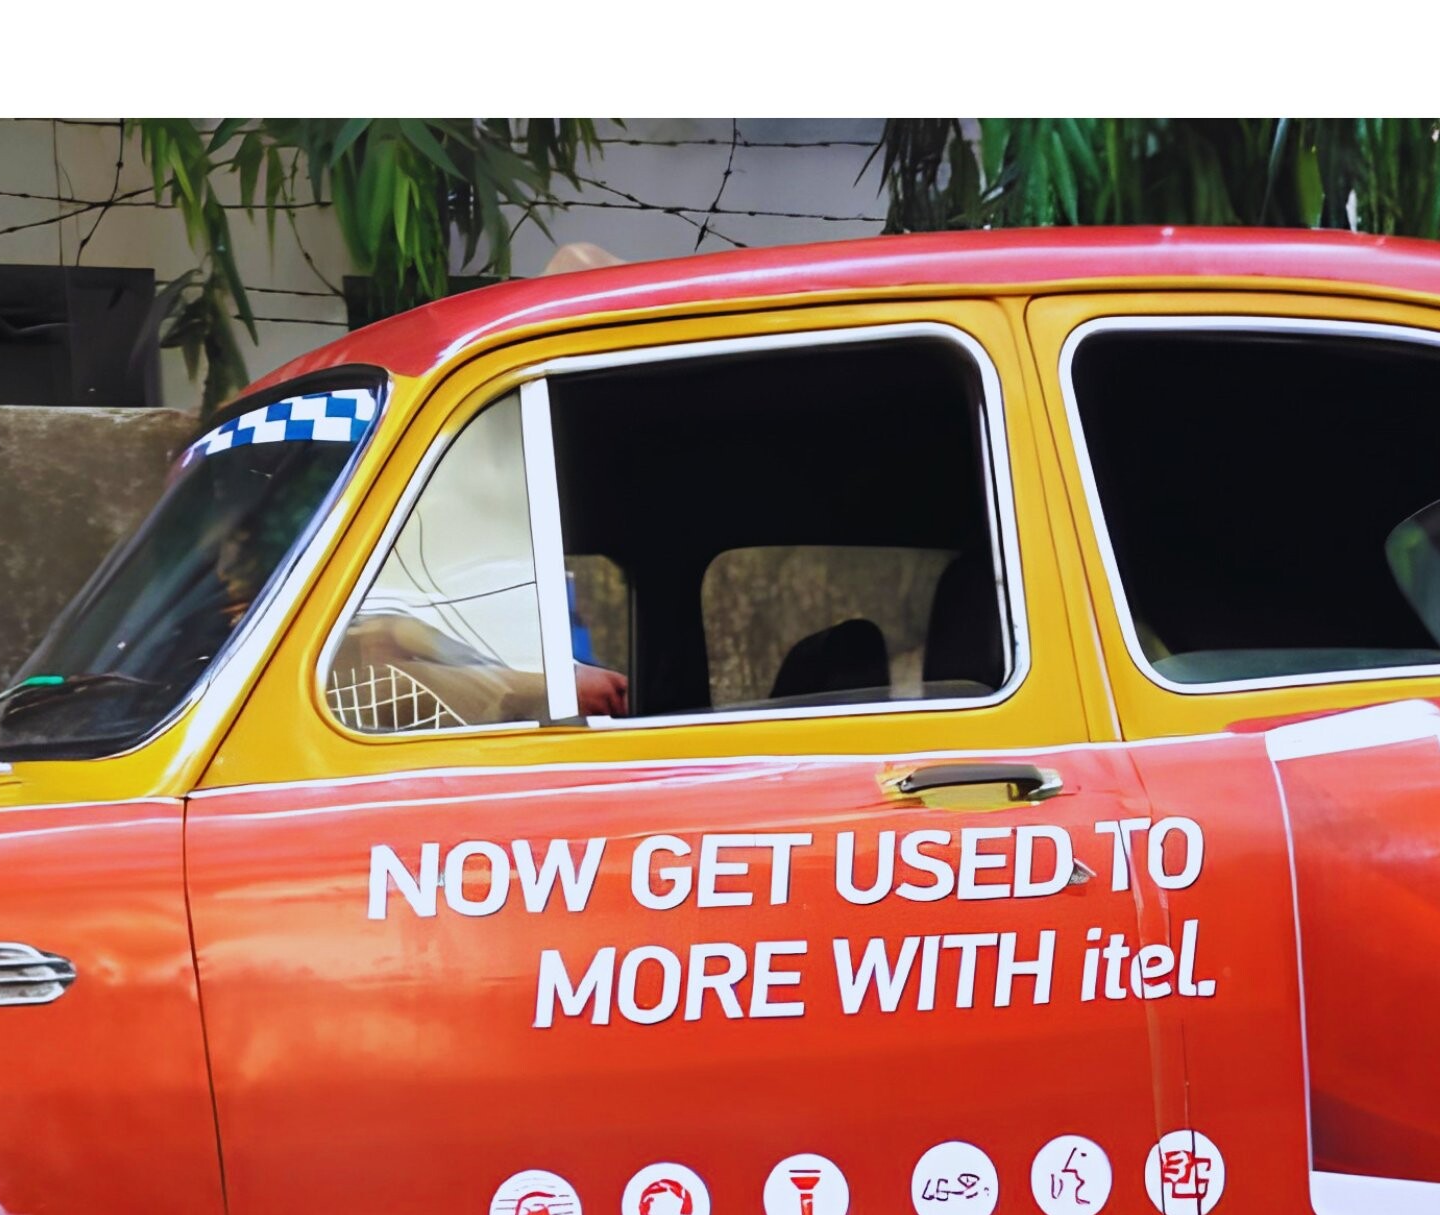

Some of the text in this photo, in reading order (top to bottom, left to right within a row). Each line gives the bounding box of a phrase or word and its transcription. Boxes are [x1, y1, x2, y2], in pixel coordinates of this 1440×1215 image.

[366, 817, 1204, 920] NOW GET USED TO
[533, 920, 1216, 1028] MORE WITH itel.
